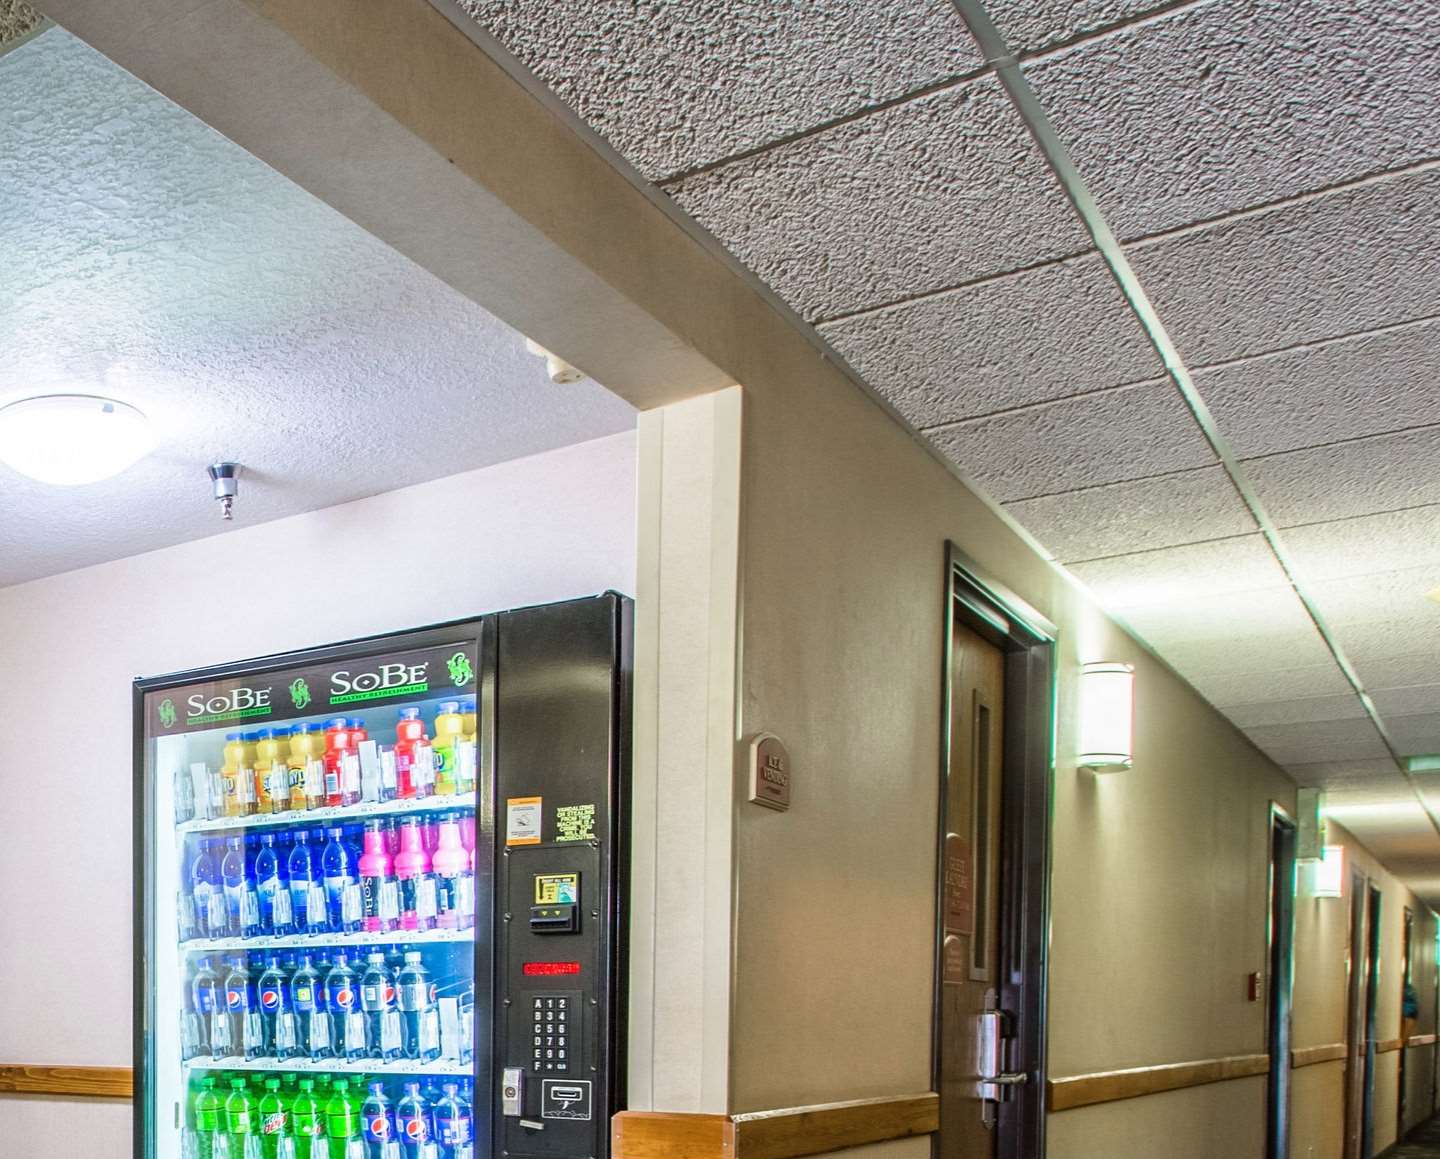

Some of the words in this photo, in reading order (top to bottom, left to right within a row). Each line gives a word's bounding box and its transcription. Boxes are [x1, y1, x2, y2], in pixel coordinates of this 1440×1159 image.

[535, 999, 541, 1008] A
[547, 999, 553, 1008] 1
[559, 999, 565, 1008] 2
[535, 1012, 541, 1020] B
[547, 1012, 553, 1020] 3
[559, 1012, 565, 1020] 4
[535, 1024, 541, 1033] C
[547, 1024, 553, 1033] 5
[559, 1024, 565, 1033] 6
[535, 1037, 541, 1046] D
[547, 1037, 553, 1046] 7
[559, 1037, 565, 1046] 8
[535, 1049, 541, 1058] E
[547, 1049, 553, 1058] 9
[559, 1049, 565, 1058] 0
[535, 1061, 540, 1070] F
